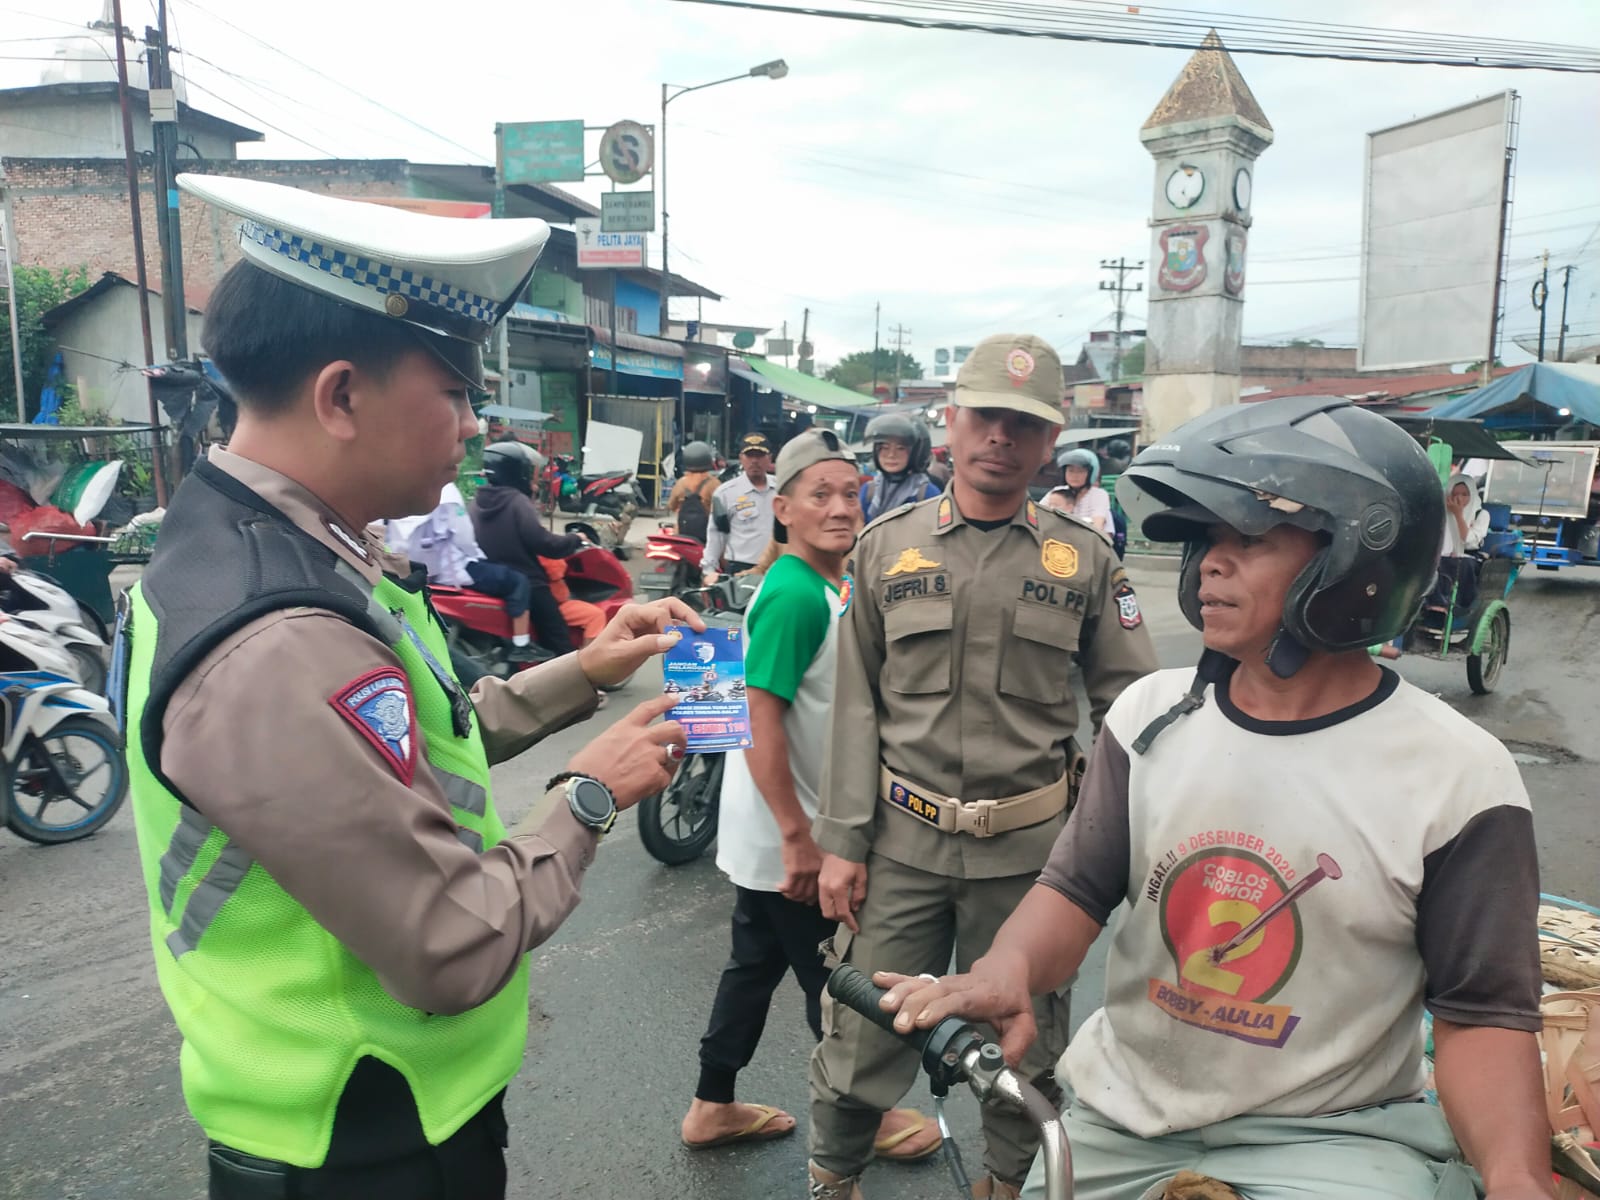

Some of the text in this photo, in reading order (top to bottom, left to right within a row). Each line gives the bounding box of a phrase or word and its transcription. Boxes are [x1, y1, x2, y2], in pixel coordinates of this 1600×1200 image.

[597, 234, 641, 246] PELITA JAYA
[884, 577, 928, 603] JEFRI
[1023, 579, 1085, 612] POL PP
[908, 793, 937, 820] POL PP
[1177, 843, 1188, 856] 9
[1189, 830, 1265, 854] DESEMBER
[1265, 847, 1296, 881] 2020
[1202, 876, 1264, 903] NOMOR
[1203, 863, 1269, 890] COBLOS
[1181, 899, 1266, 996] 2
[1156, 985, 1204, 1015] BOBBY
[1210, 1005, 1275, 1031] AULIA
